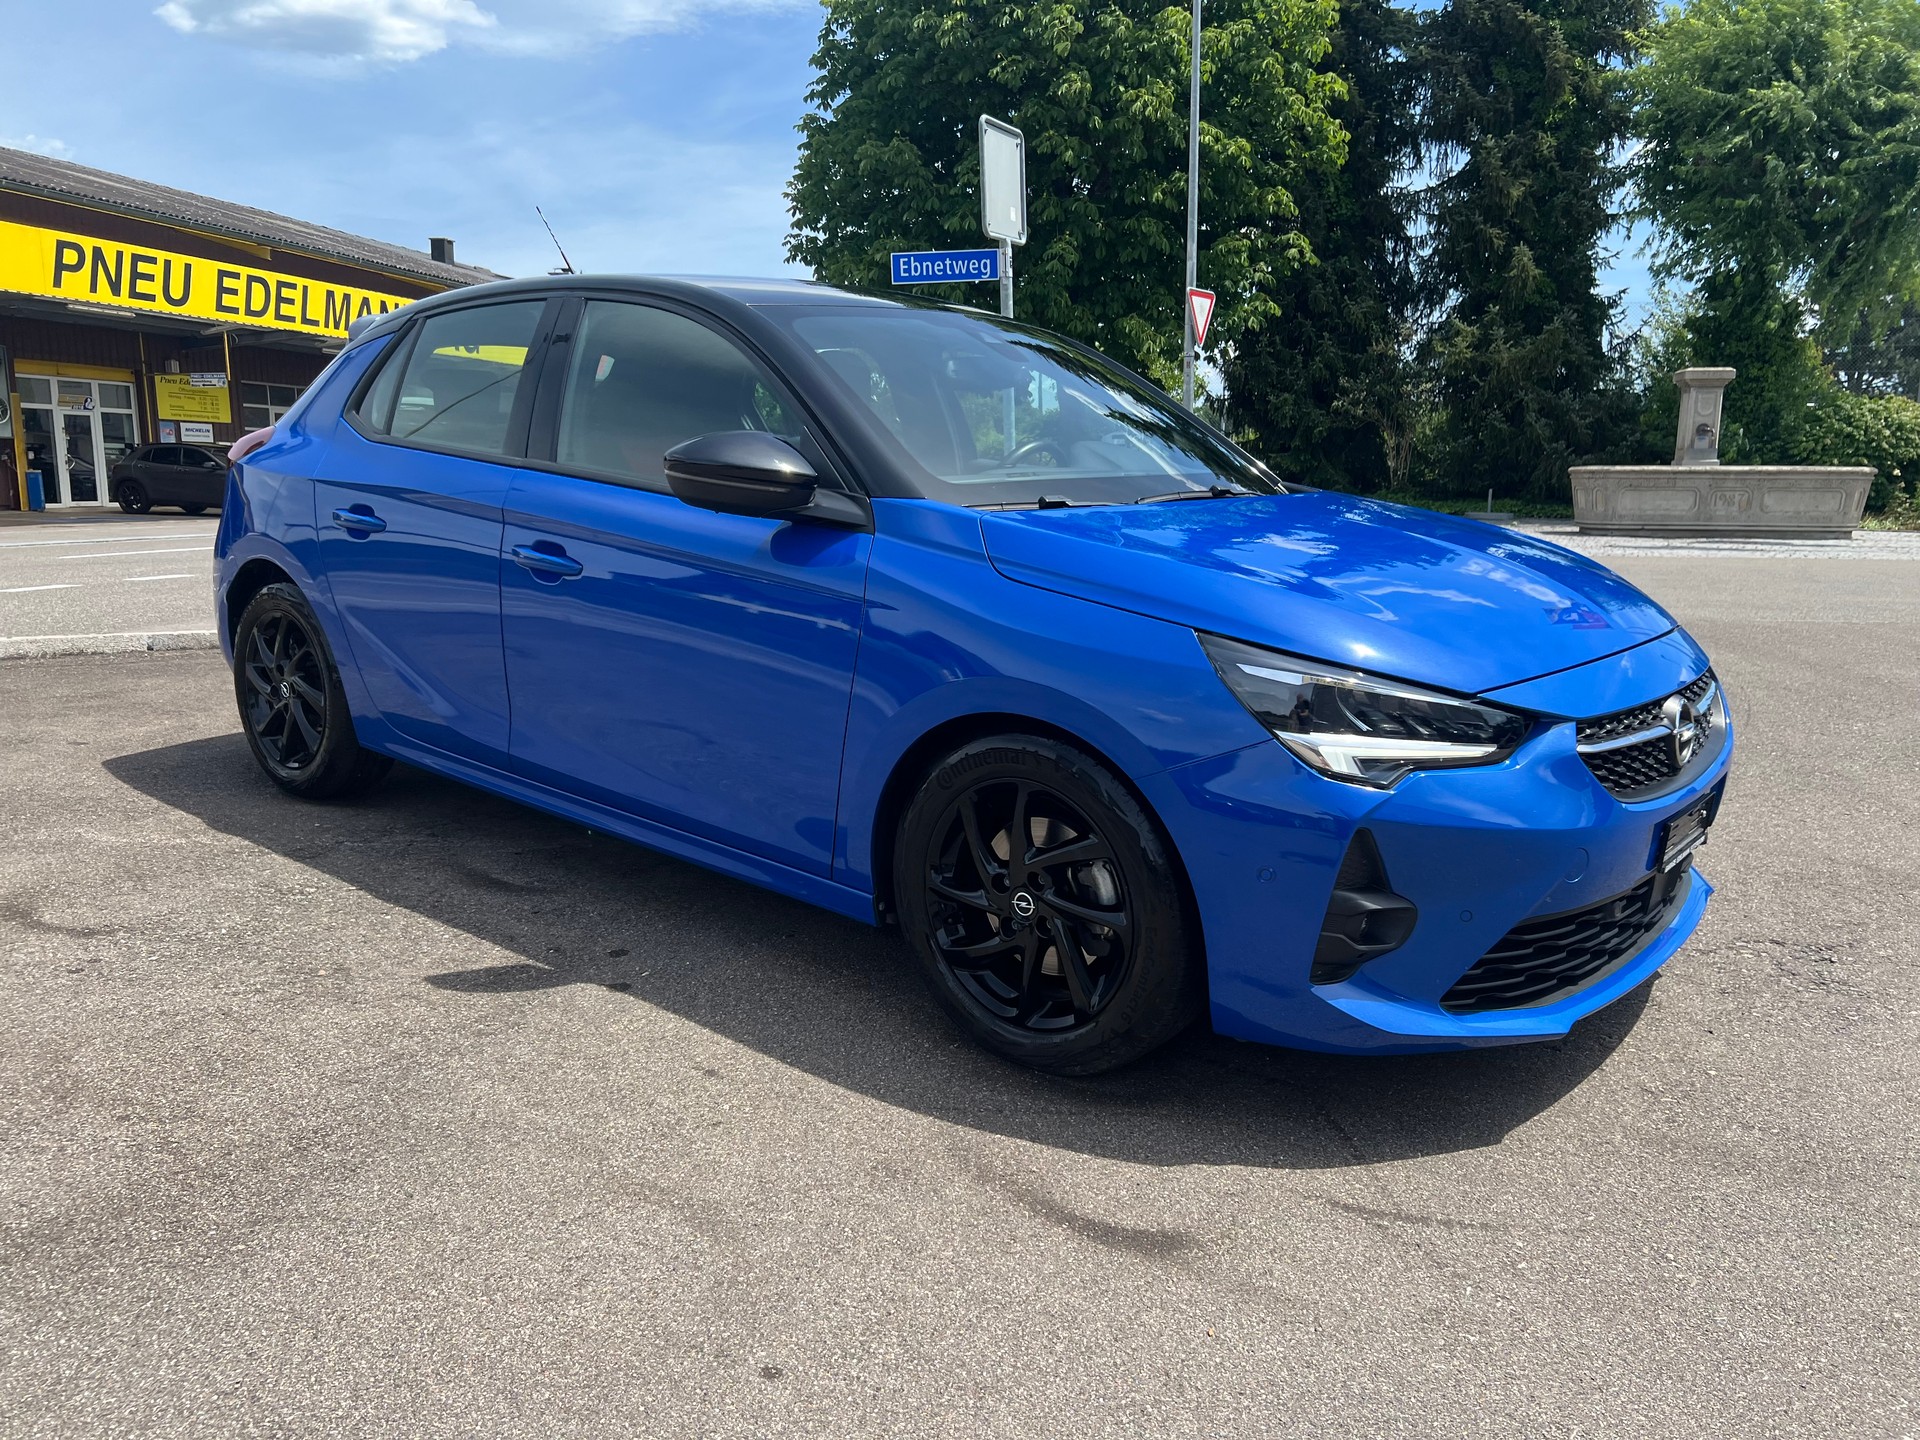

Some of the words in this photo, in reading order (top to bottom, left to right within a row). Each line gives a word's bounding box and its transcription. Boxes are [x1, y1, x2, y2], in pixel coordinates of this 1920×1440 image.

[52, 239, 192, 307] PNEU
[900, 256, 991, 279] Ebnetweg
[936, 747, 1027, 790] Continental
